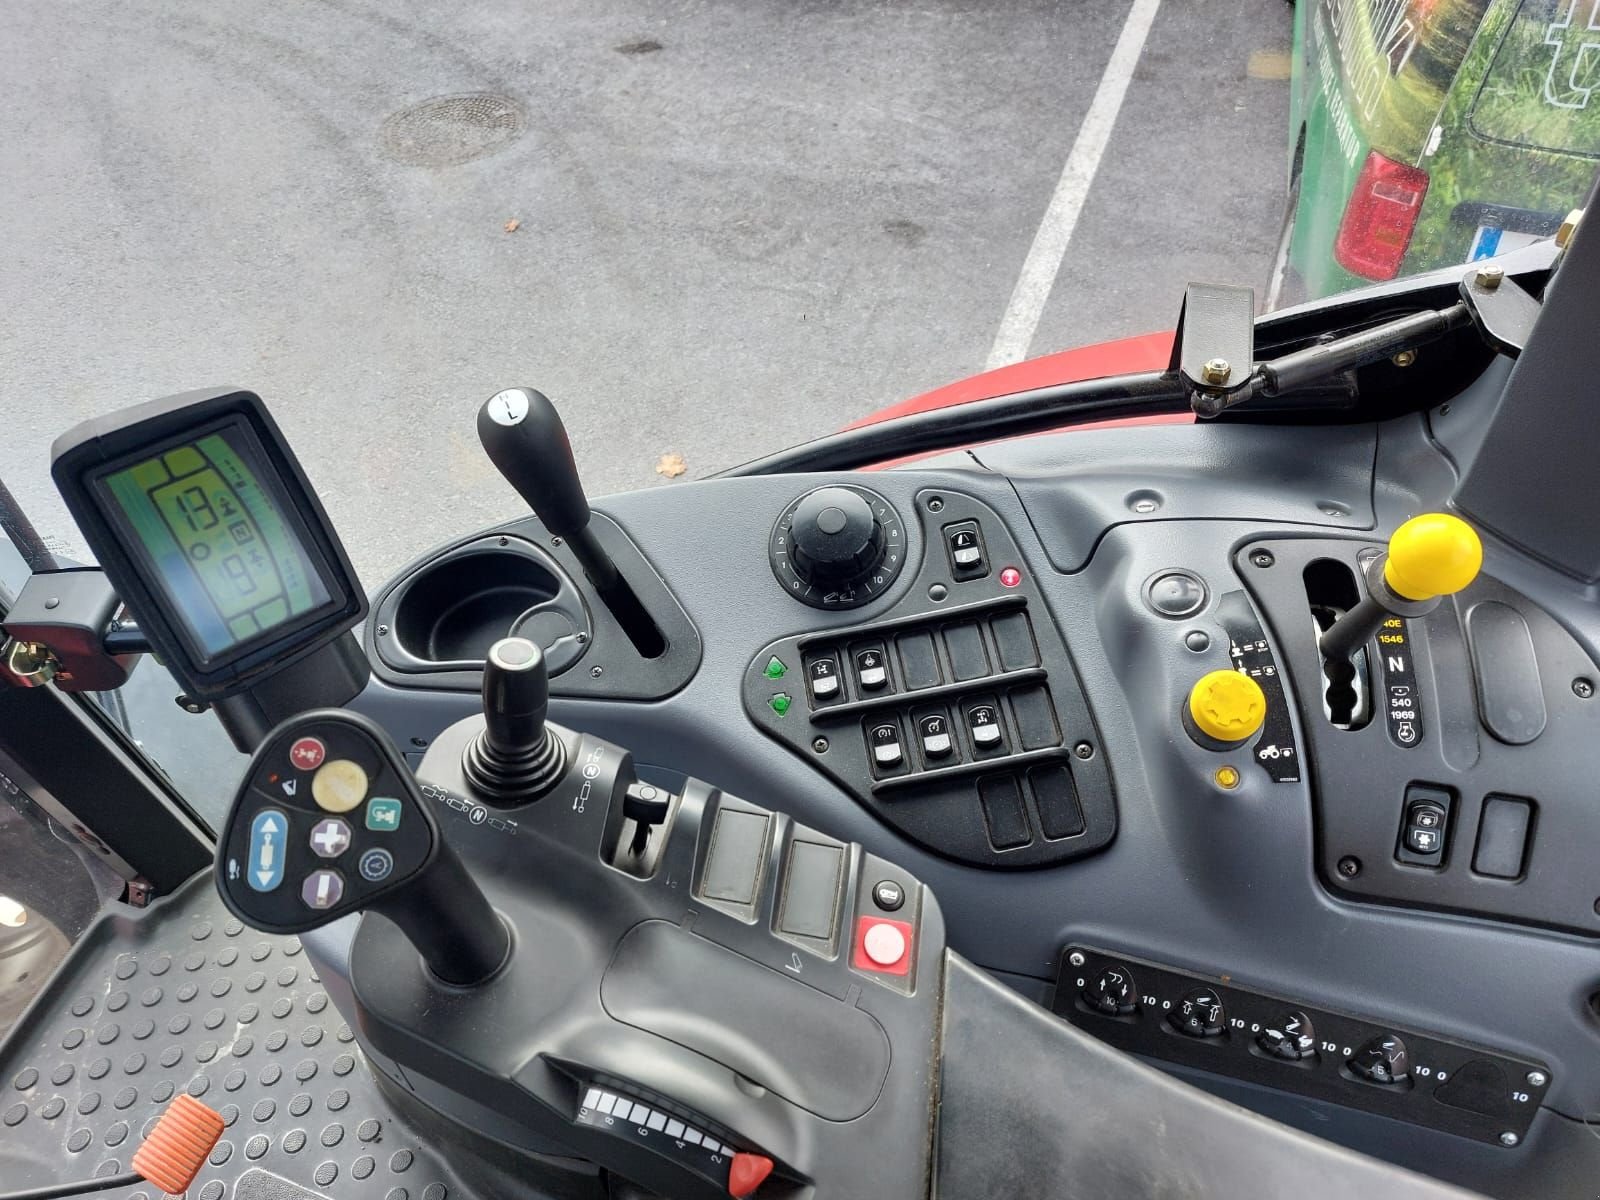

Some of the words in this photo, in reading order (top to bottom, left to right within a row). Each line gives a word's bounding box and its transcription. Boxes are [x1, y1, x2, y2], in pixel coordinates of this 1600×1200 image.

[794, 581, 799, 589] 0
[1379, 634, 1404, 644] 1546
[1388, 656, 1404, 672] N
[1391, 698, 1412, 707] 540
[1391, 710, 1415, 720] 1969
[1076, 978, 1085, 987] 0
[1142, 995, 1156, 1006] 10
[1162, 1000, 1171, 1009] 0
[1230, 1018, 1245, 1029] 10
[1251, 1023, 1260, 1033] 0
[1321, 1041, 1337, 1052] 10
[1343, 1047, 1352, 1056] 0
[1415, 1065, 1431, 1077] 10
[1437, 1071, 1447, 1081] 0
[1512, 1091, 1529, 1103] 10
[604, 1116, 615, 1126] 8
[637, 1126, 649, 1137] 6
[675, 1140, 686, 1149] 4
[710, 1154, 722, 1164] 2
